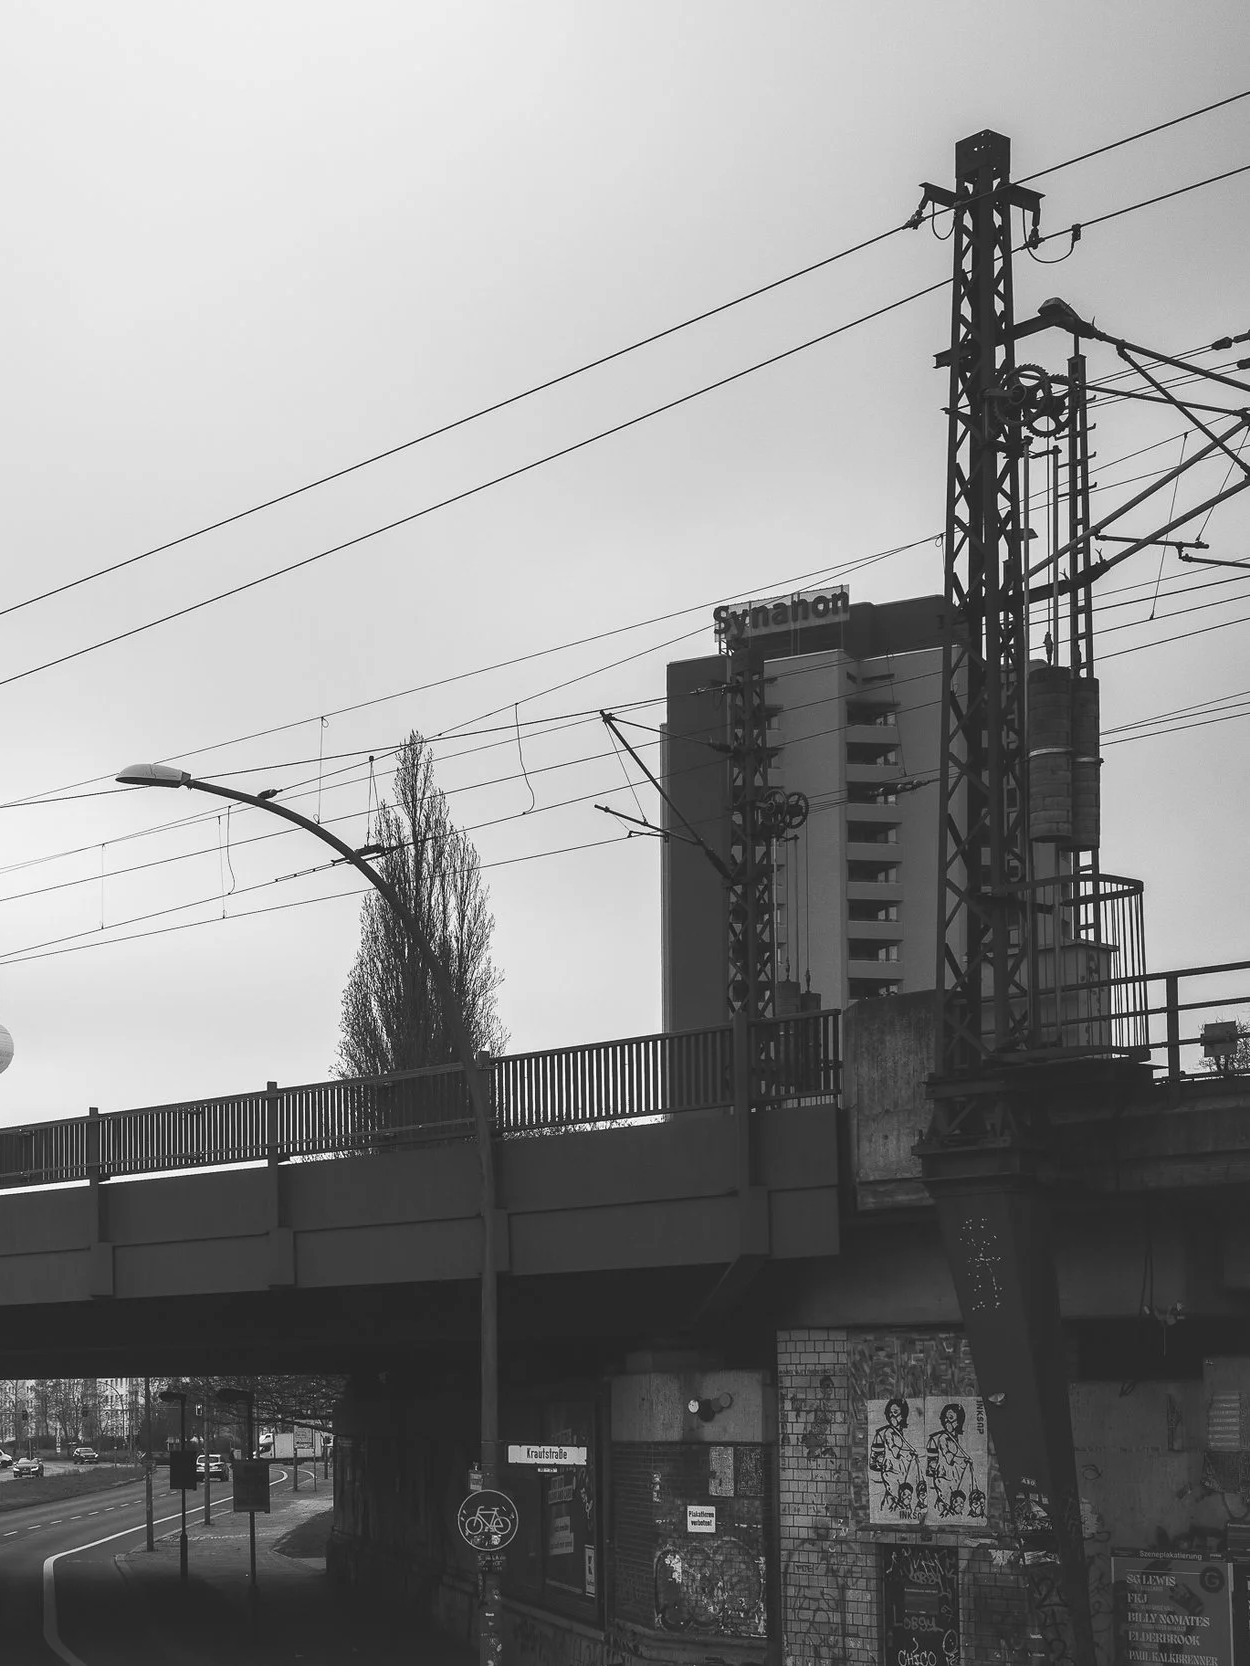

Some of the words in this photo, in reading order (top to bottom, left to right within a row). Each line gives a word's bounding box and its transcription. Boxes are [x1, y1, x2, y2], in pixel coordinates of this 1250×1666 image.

[526, 1447, 568, 1459] Krautstraße
[689, 1510, 715, 1518] Plakatieren
[1139, 1550, 1203, 1561] Szeneplakatierung
[1126, 1574, 1141, 1585] SG
[1142, 1575, 1177, 1586] LEWIS
[1127, 1612, 1157, 1623] BILLY
[1159, 1613, 1211, 1627] NOMATES
[1128, 1631, 1201, 1646] ELDERBROOK
[1128, 1650, 1152, 1662] PAUL
[1152, 1651, 1218, 1666] KALKBRENNER
